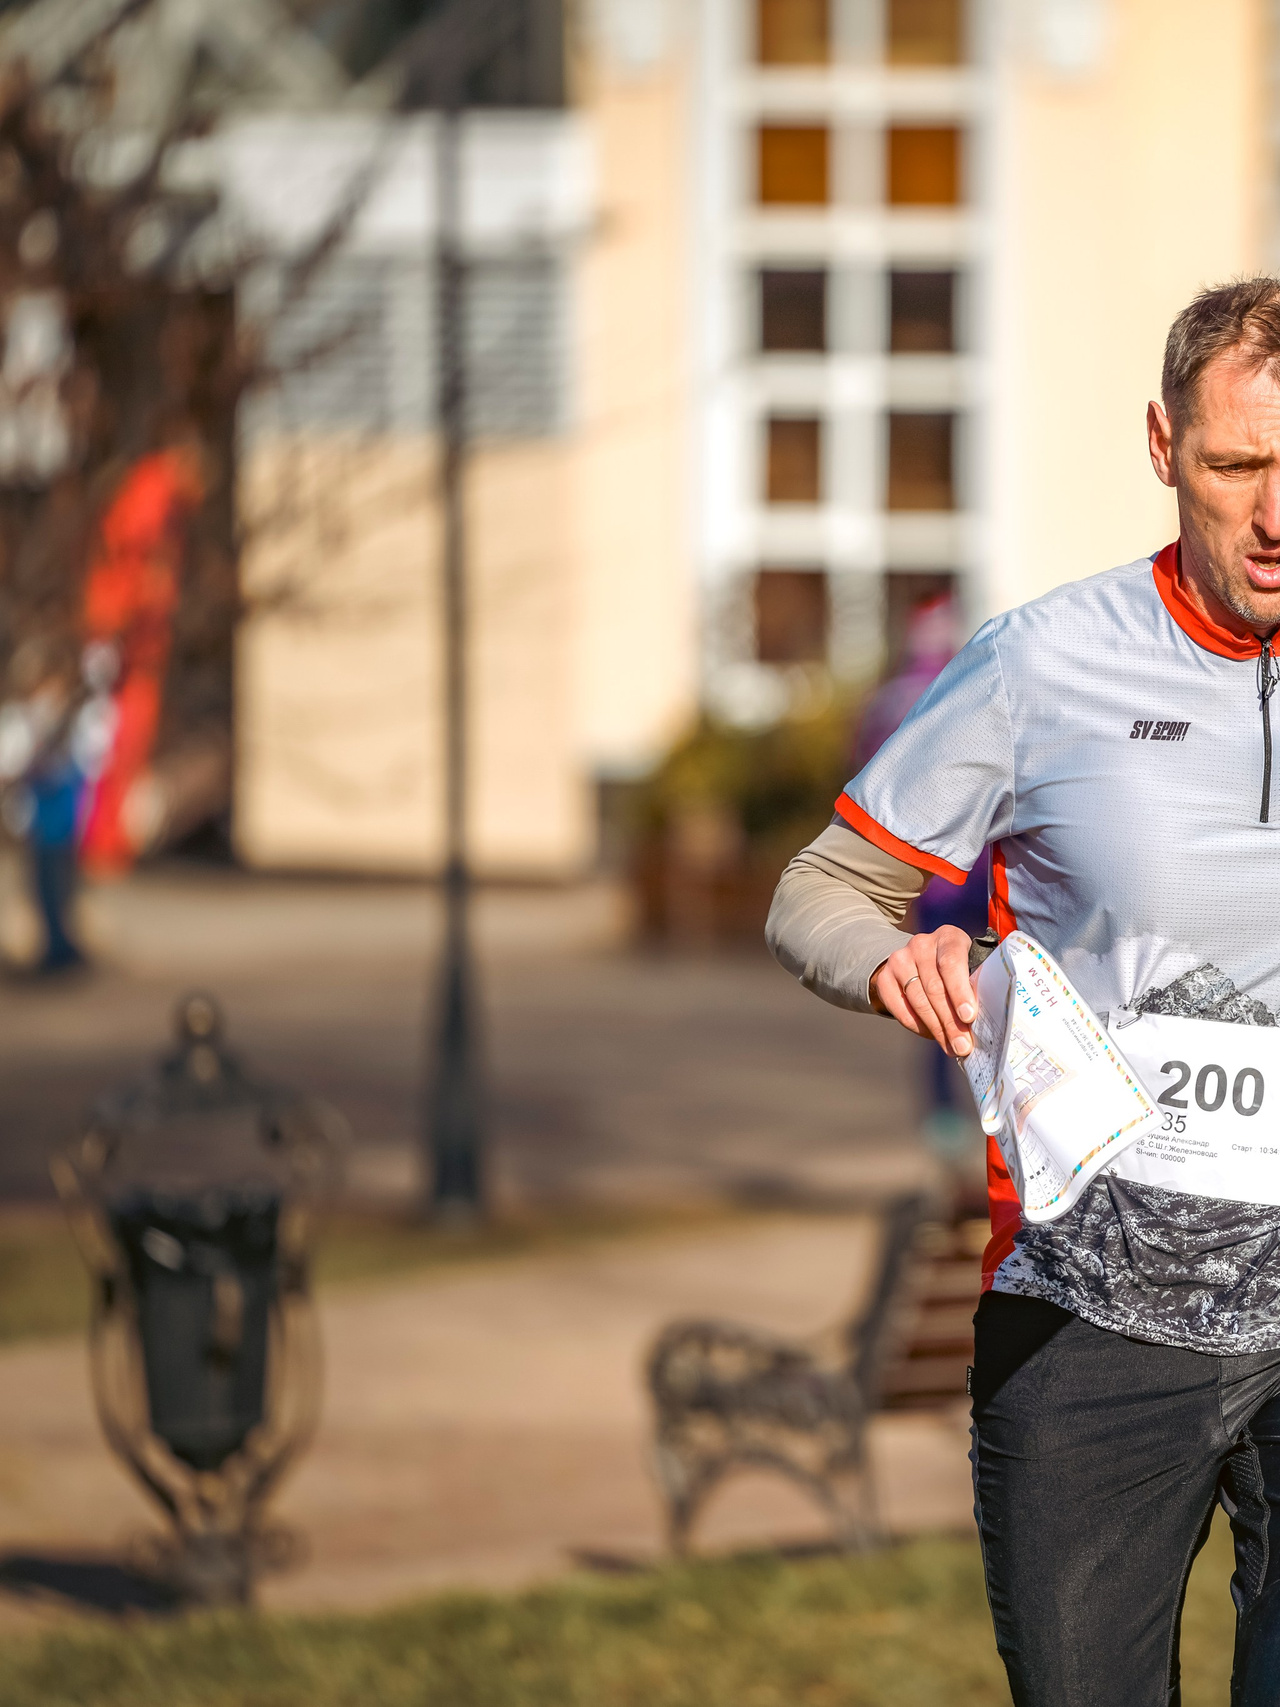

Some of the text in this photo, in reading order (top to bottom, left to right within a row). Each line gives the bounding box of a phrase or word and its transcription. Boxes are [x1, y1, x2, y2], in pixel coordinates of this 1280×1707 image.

[1129, 720, 1191, 739] SV SPORT
[1157, 1060, 1265, 1117] 200
[1171, 1135, 1210, 1149] Александр
[1231, 1143, 1253, 1153] Старт
[1160, 1152, 1186, 1163] 000000
